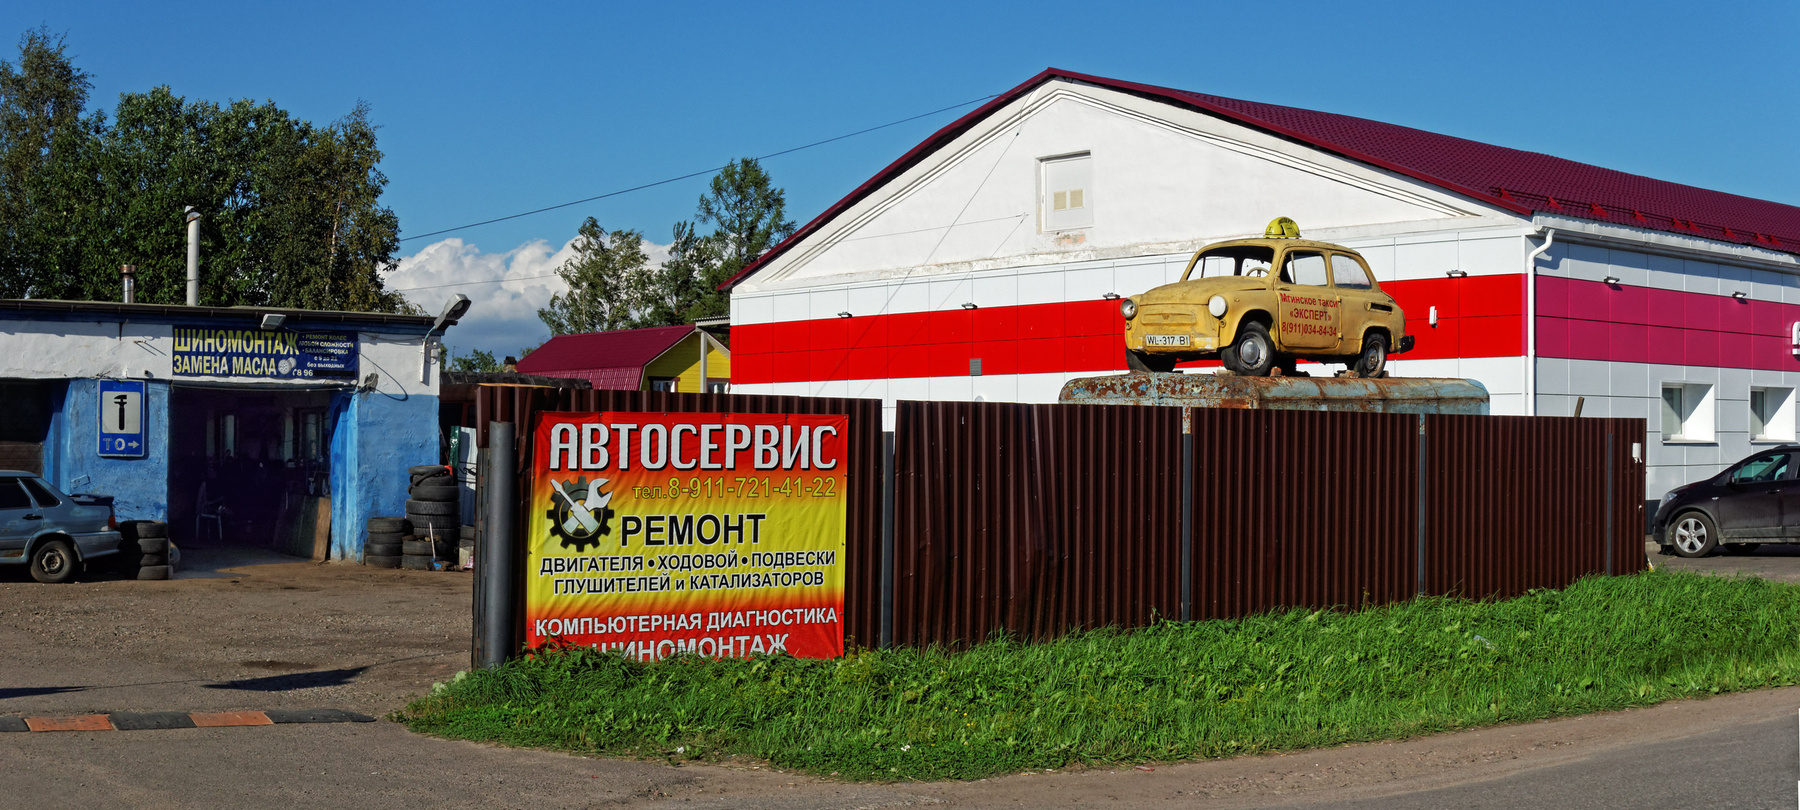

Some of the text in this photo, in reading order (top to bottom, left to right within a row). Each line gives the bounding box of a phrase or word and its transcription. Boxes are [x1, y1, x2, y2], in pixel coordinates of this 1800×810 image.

[1290, 308, 1332, 321] «ЭКСПЕРТ»
[1318, 299, 1338, 308] такси
[174, 328, 300, 355] ШИНОМОНТАЖ
[1281, 321, 1337, 337] 8(911)034-84-34
[173, 355, 277, 376] ЗАМЕНА МАСЛА
[549, 422, 839, 471] АВТОСЕРВИС
[620, 513, 767, 547] РЕМОНТ
[540, 549, 836, 576] ДВИГАТЕЛЯ ХОДОВОЙ ПОДВЕСКИ
[553, 571, 824, 595] ГЛУШИТЕЛЕЙ и КАТАЛИЗАТОРОВ
[535, 606, 838, 637] КОМПЬЮТЕРНАЯ ДИАГНОСТИКА
